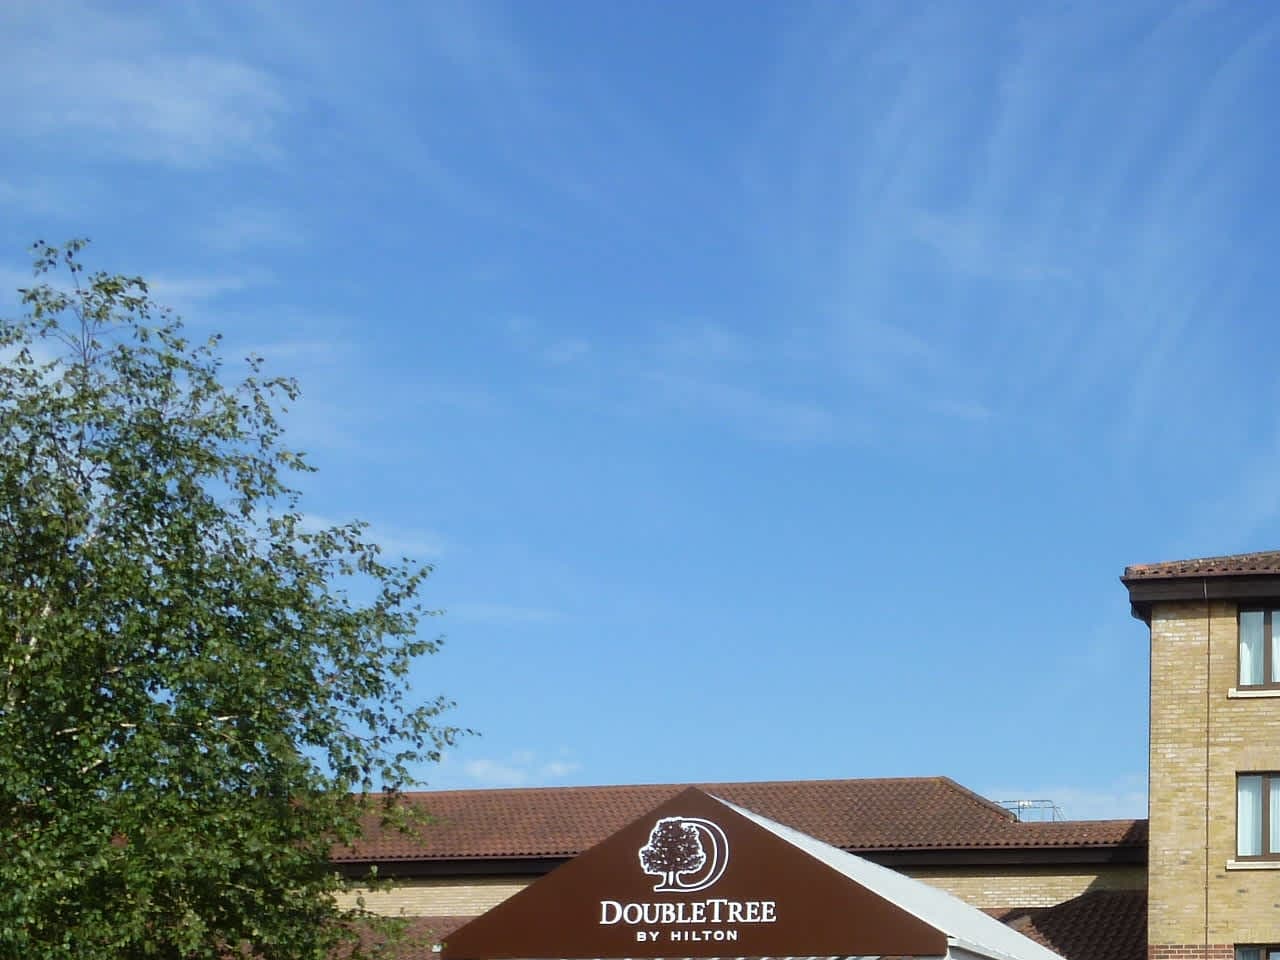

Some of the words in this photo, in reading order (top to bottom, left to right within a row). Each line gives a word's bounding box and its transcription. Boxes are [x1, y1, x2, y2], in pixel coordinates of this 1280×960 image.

[600, 899, 776, 924] DOUBLETREE
[637, 931, 659, 942] BY
[671, 930, 738, 941] HILTON
